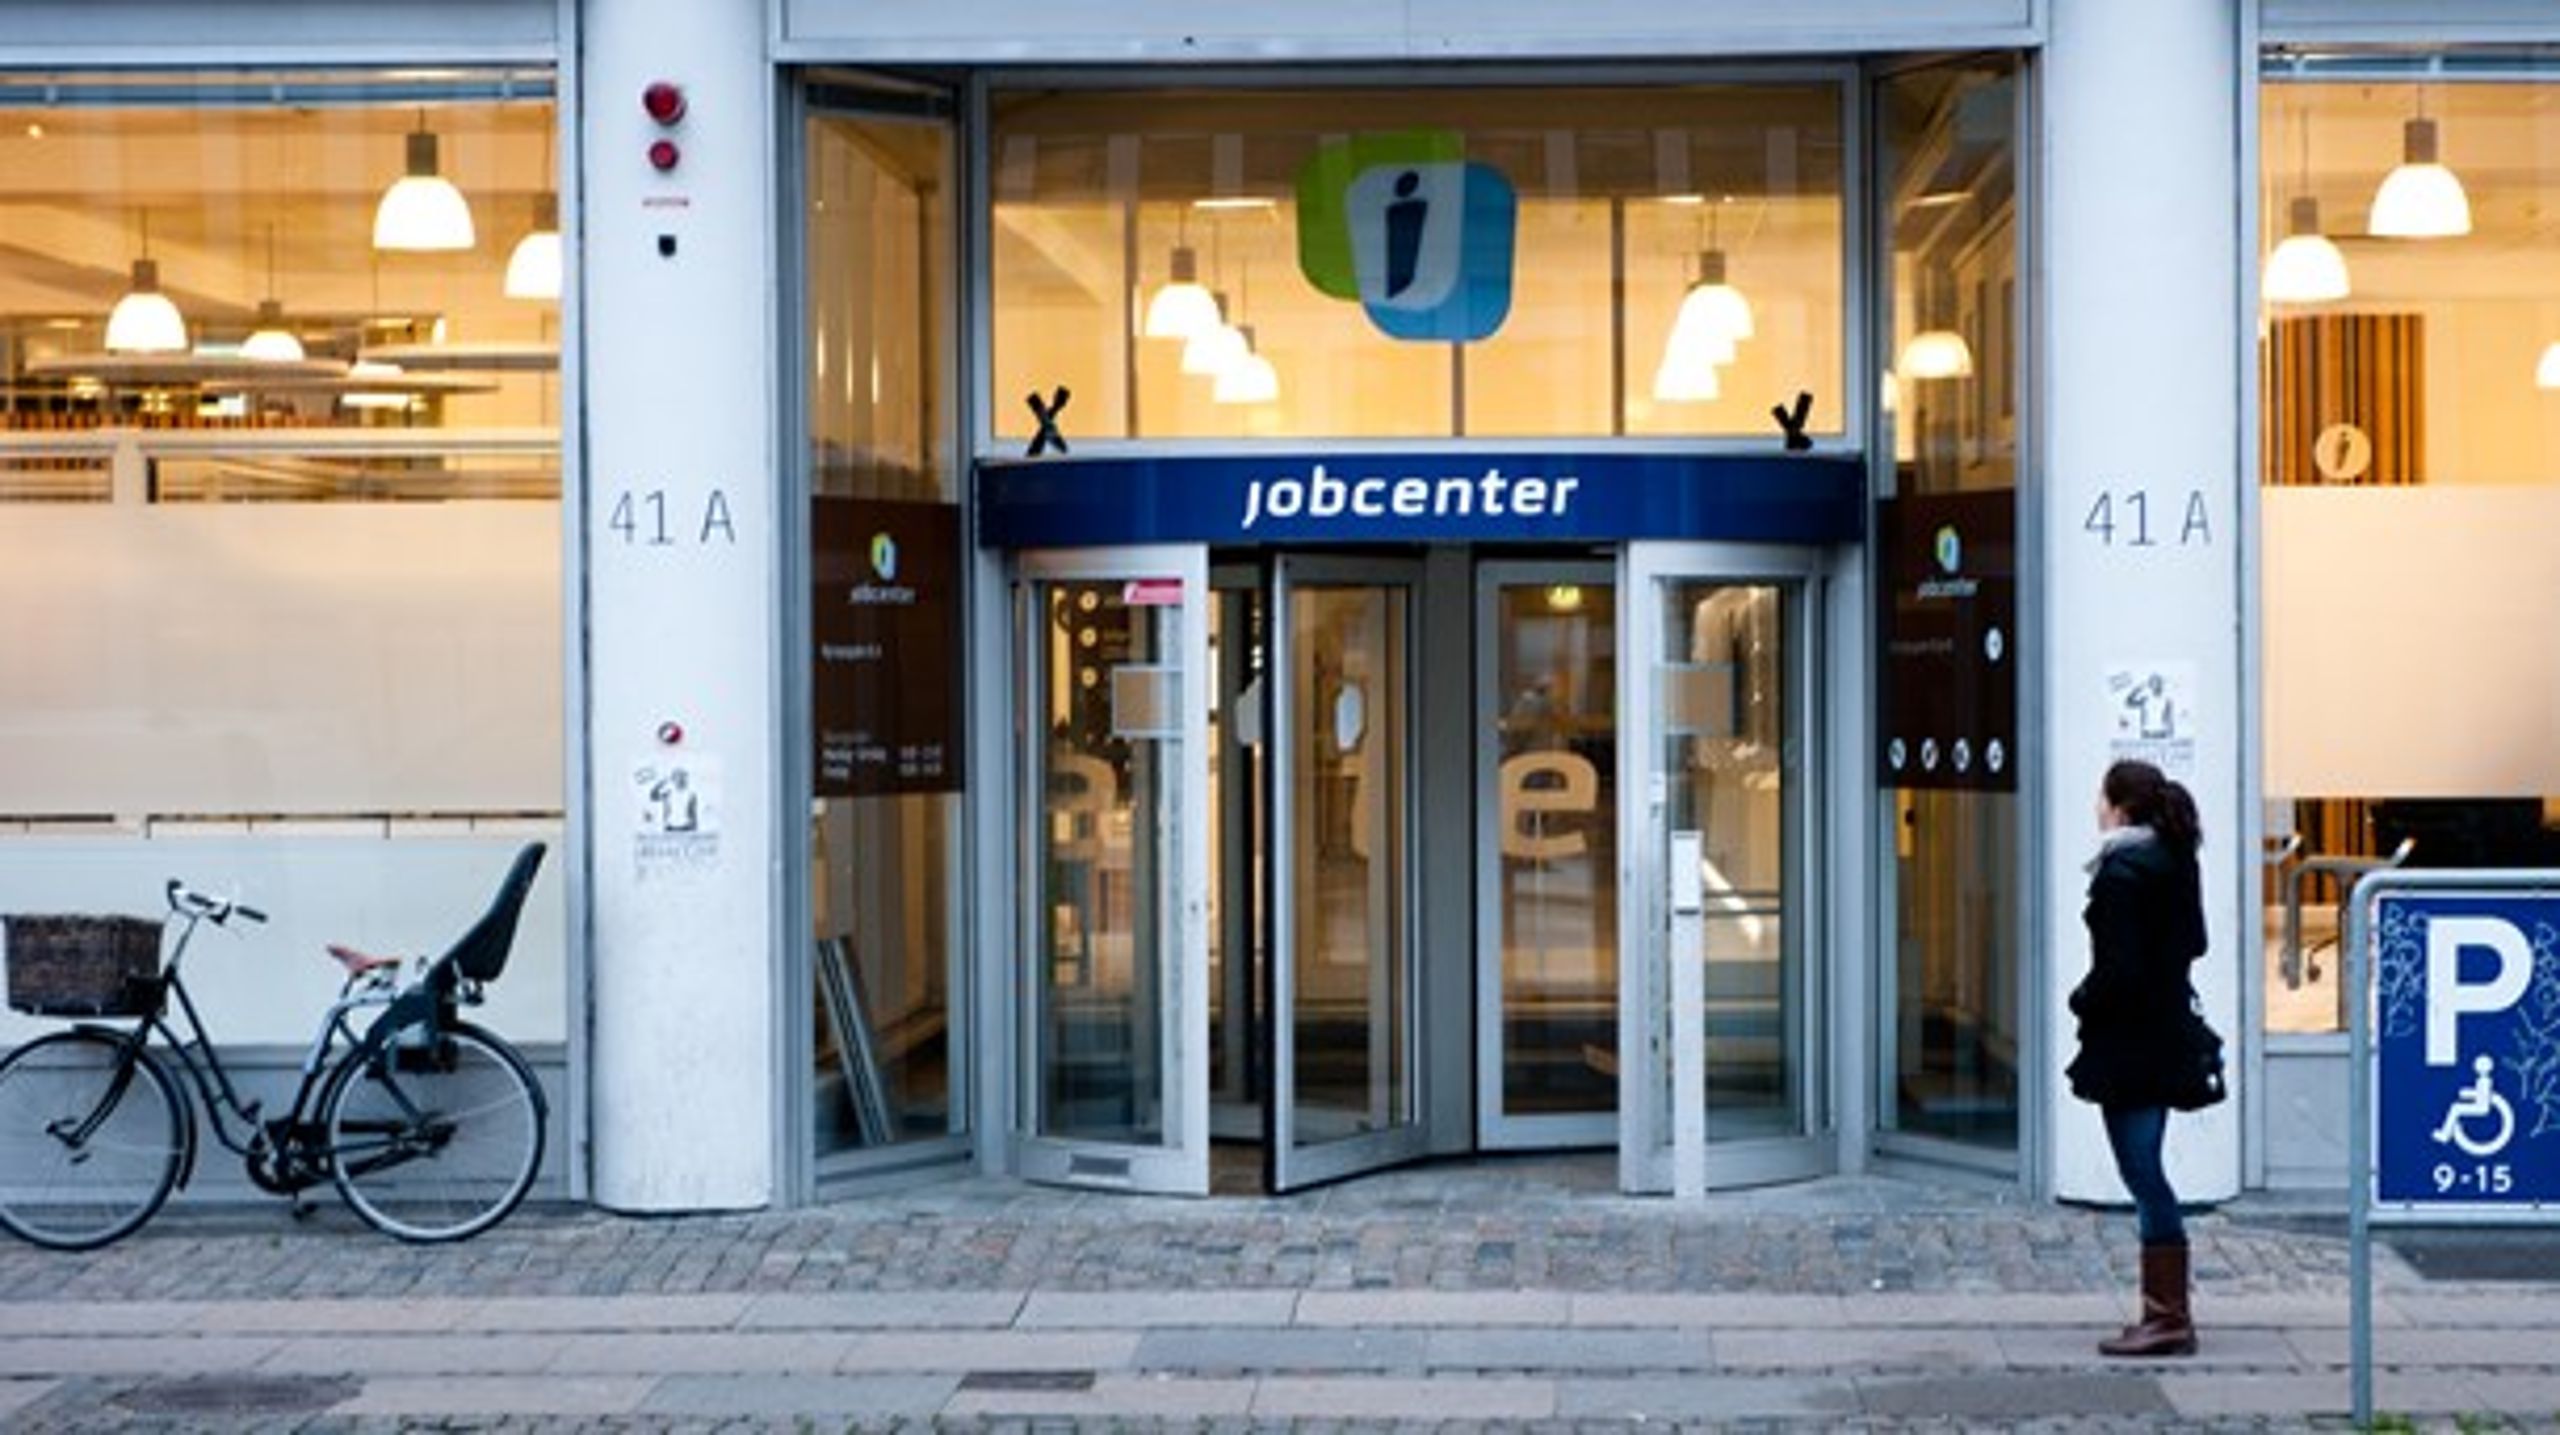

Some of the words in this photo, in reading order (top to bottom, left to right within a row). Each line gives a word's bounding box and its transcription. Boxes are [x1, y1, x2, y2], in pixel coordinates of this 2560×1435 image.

[609, 490, 674, 545] 41
[700, 489, 735, 543] A
[1242, 465, 1579, 529] jobcenter
[2084, 490, 2157, 546] 41
[2181, 490, 2212, 545] A
[2426, 916, 2533, 1066] P
